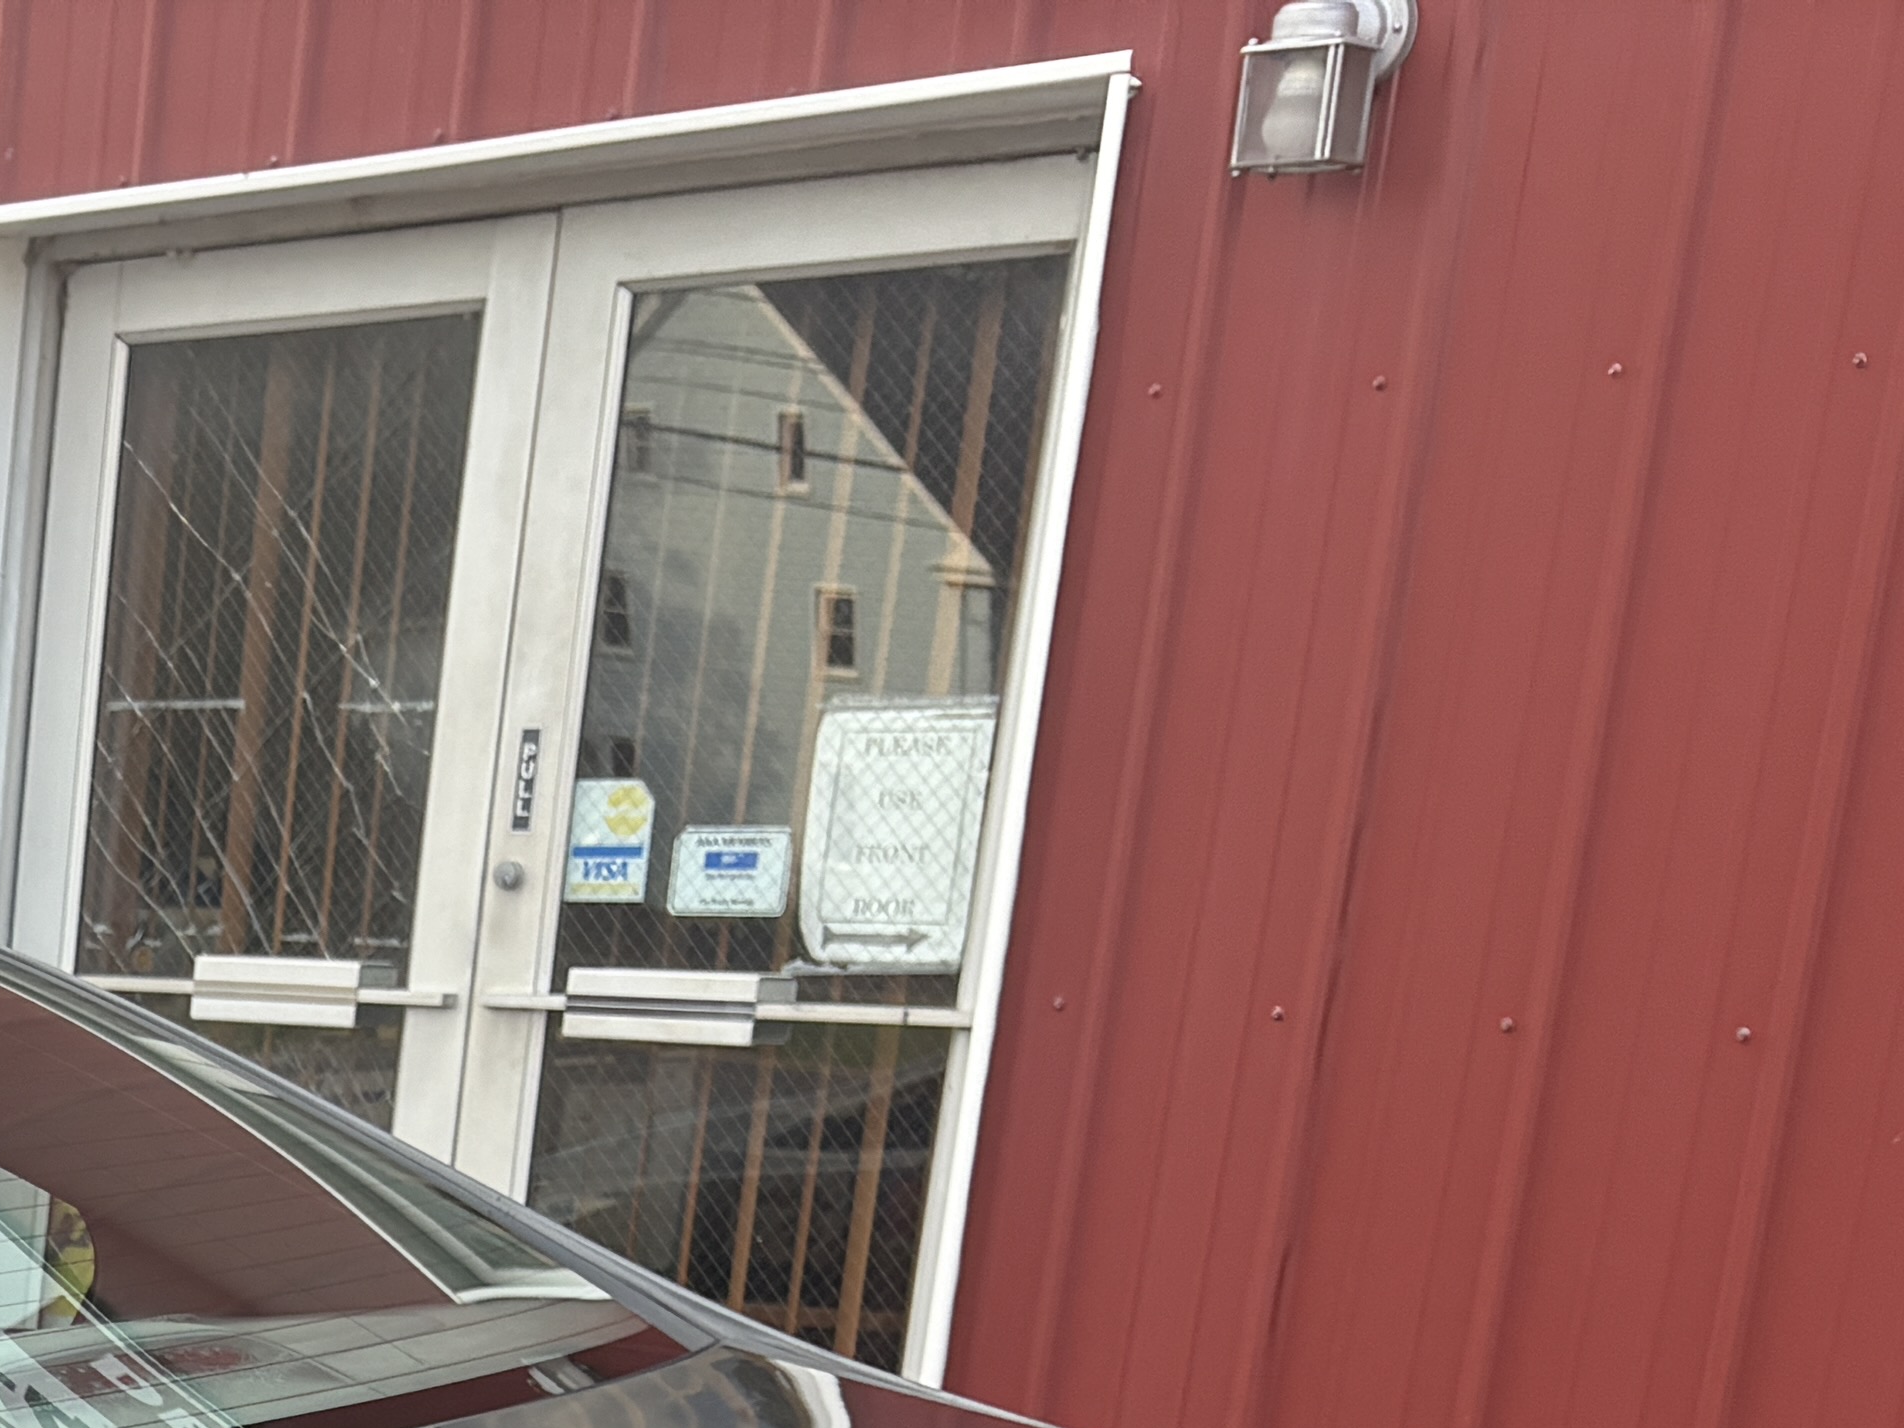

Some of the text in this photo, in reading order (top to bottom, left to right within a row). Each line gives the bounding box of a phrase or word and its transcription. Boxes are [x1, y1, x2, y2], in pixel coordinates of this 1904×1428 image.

[864, 735, 953, 757] PLEASE
[516, 741, 537, 817] PULL
[878, 789, 922, 810] USE
[853, 844, 930, 865] FRONT
[583, 860, 628, 881] VISA
[851, 898, 915, 917] DOOR
